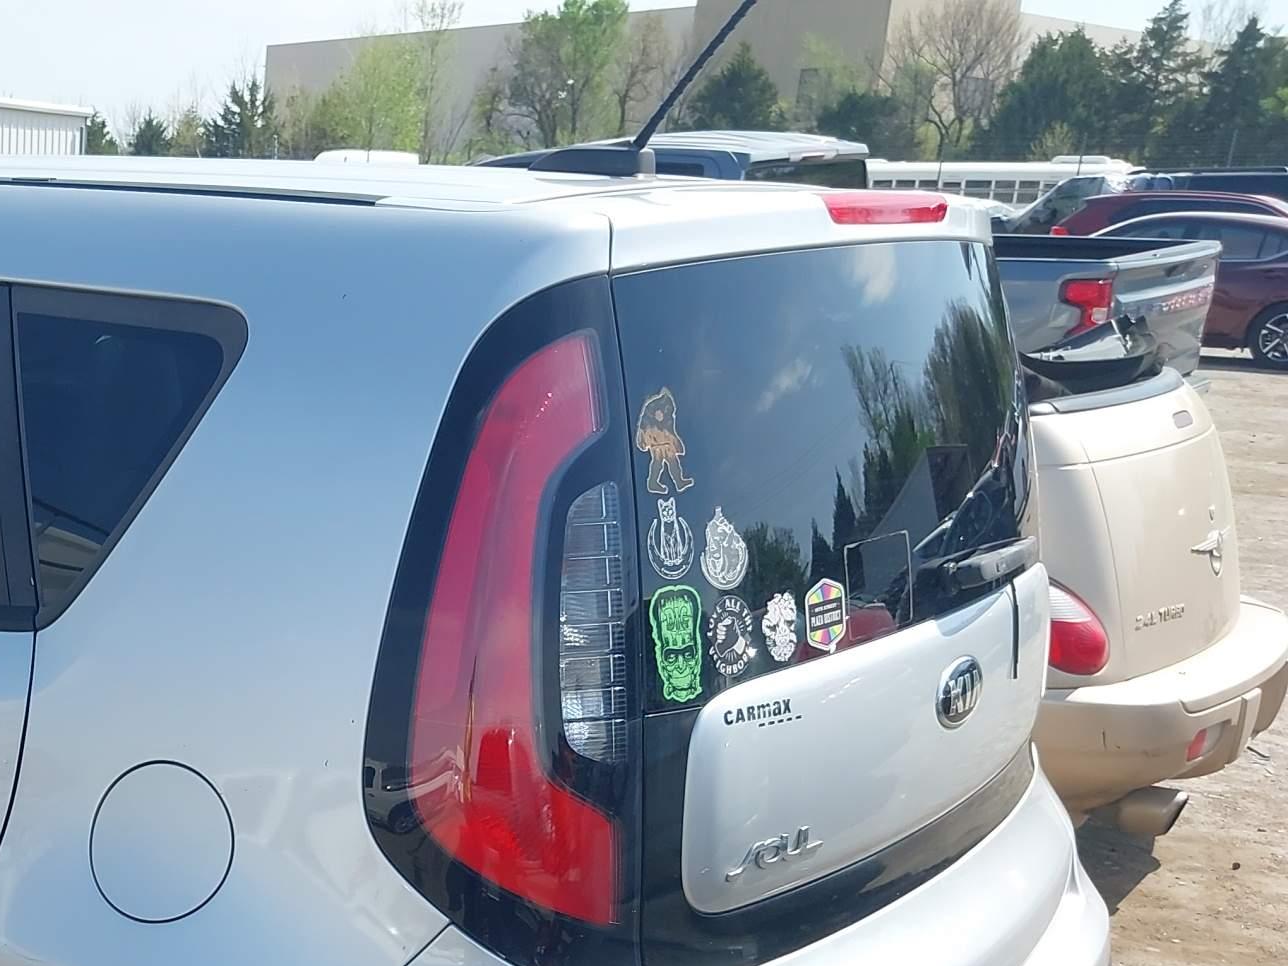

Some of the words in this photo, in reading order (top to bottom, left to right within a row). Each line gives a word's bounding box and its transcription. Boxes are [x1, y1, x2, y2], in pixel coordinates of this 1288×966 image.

[724, 598, 741, 613] ALL
[811, 614, 824, 627] PLAZA
[824, 609, 842, 624] DISTRICT
[948, 669, 980, 717] KIA
